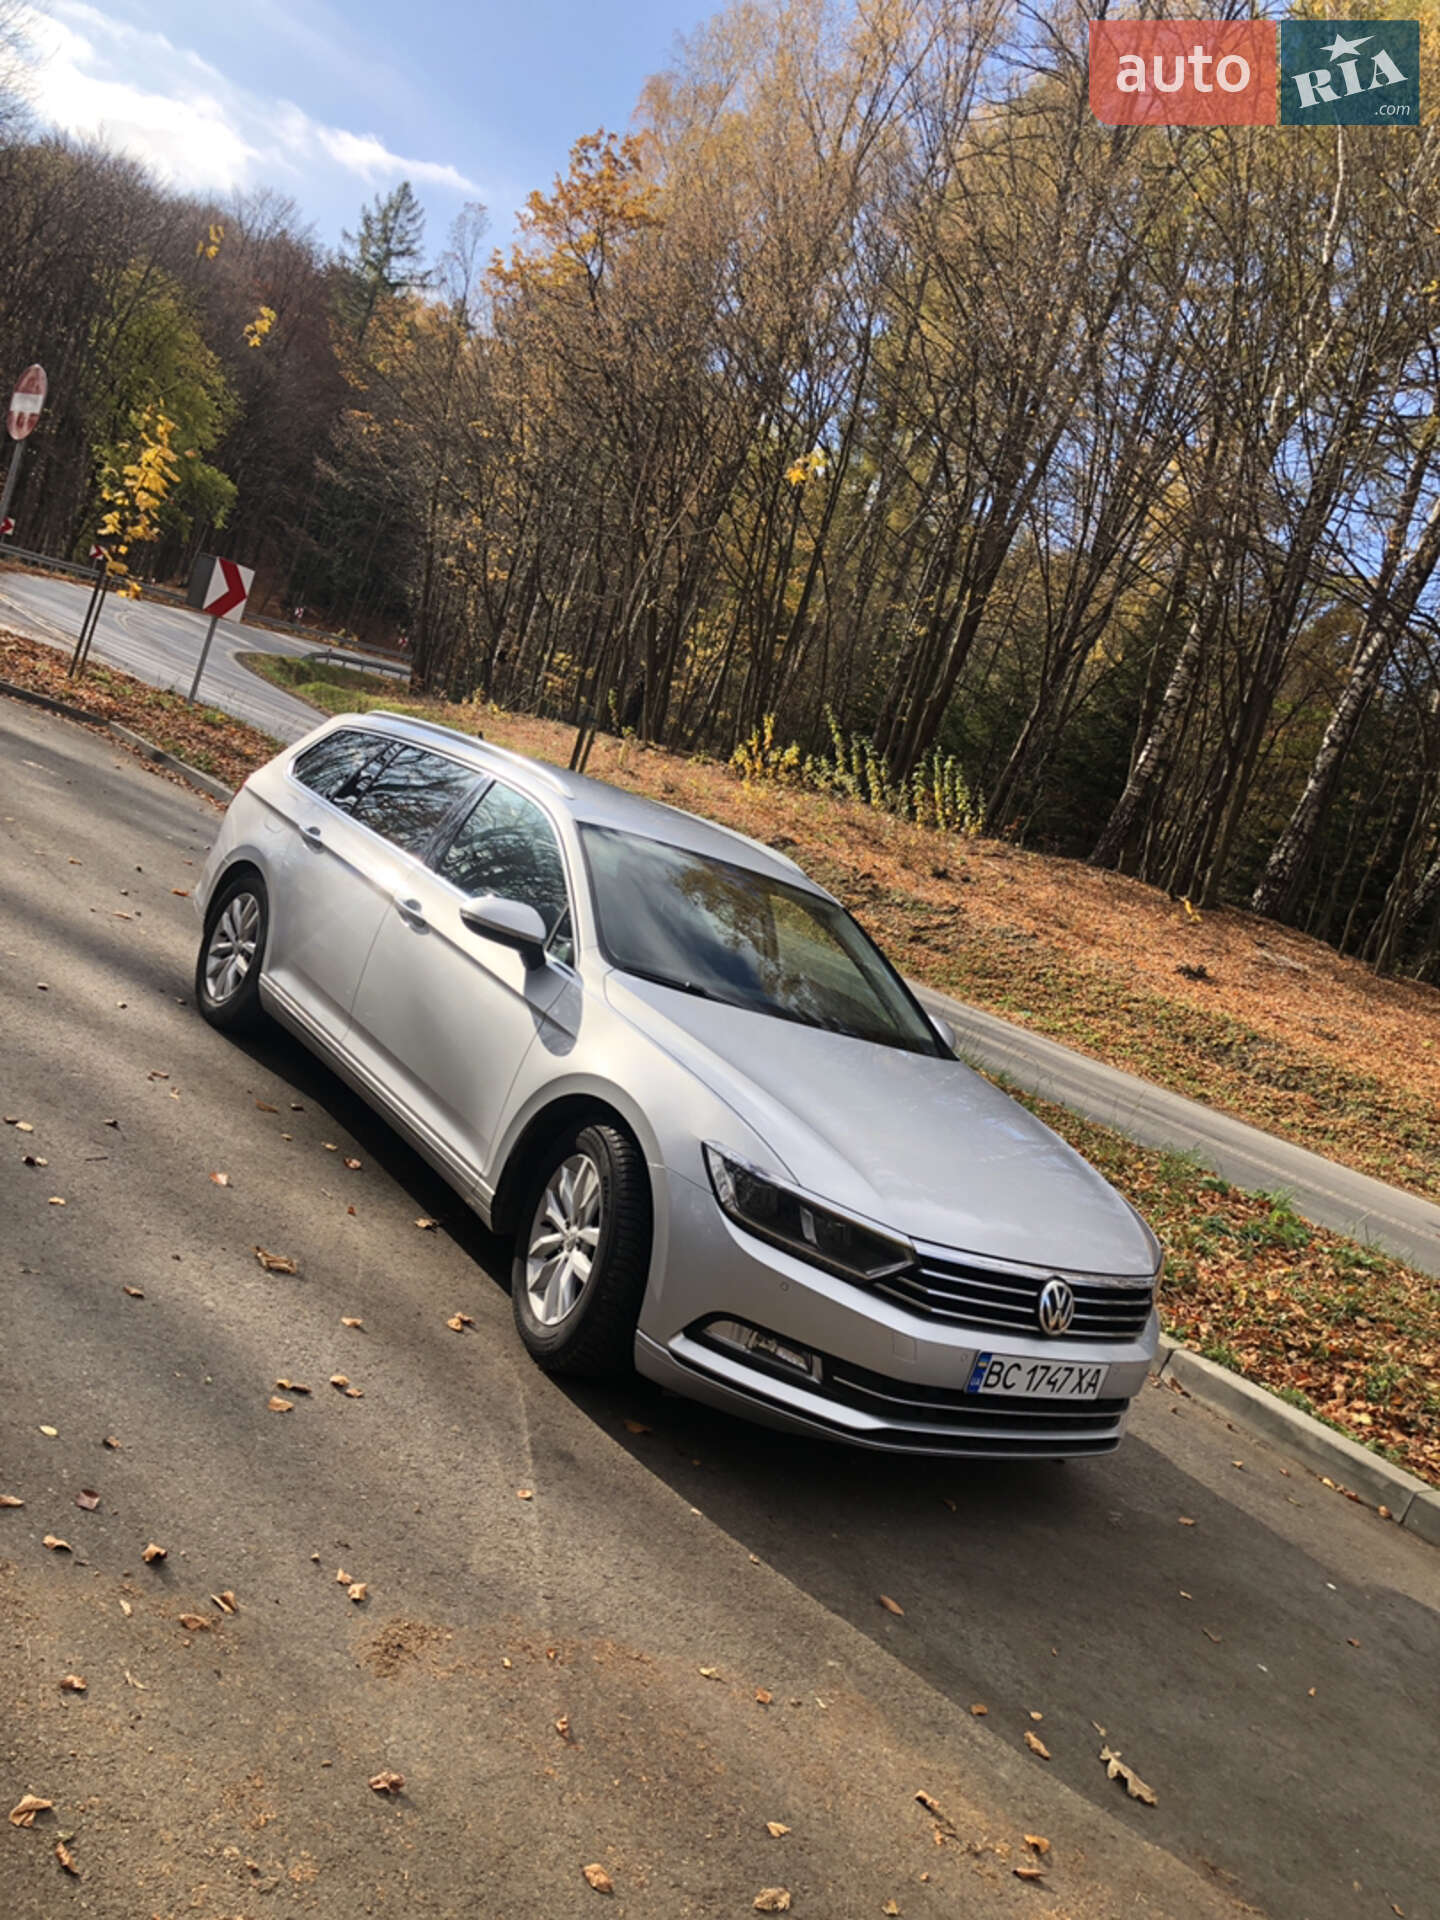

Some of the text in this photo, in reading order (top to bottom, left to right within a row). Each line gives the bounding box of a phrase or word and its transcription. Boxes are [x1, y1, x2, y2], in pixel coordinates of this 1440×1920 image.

[983, 1360, 1101, 1395] BC 1747 XA
